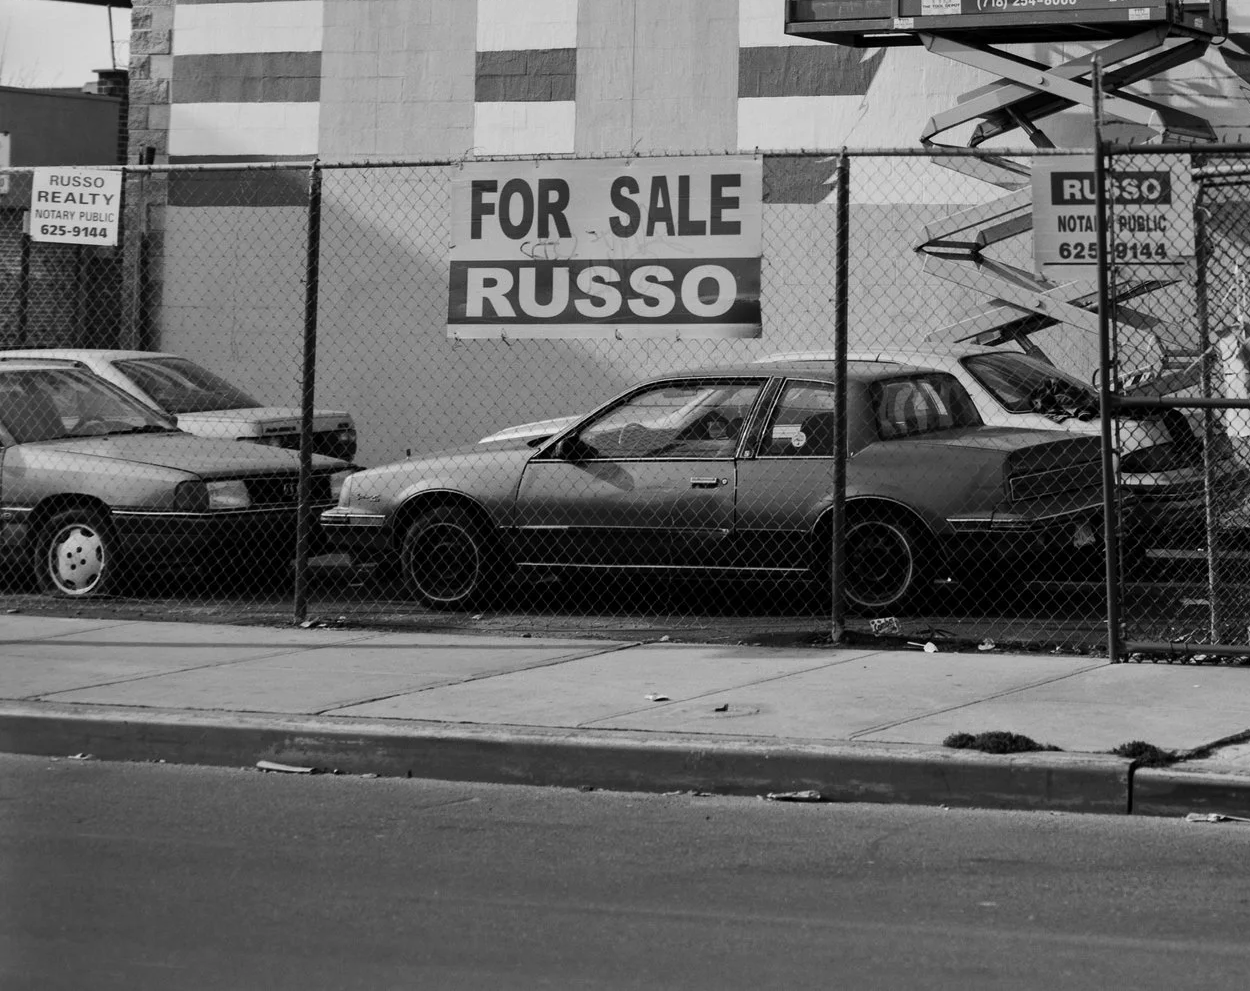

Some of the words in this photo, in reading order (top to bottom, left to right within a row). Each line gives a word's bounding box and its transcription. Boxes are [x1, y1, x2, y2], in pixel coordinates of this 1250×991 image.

[49, 175, 105, 188] RUSSO
[37, 190, 115, 206] REALTY
[471, 178, 572, 240] FOR
[609, 174, 742, 238] SALE
[35, 209, 76, 221] NOTARY
[79, 211, 115, 223] PUBLIC
[1119, 215, 1167, 232] PUBLIC
[40, 224, 108, 238] 625-9144
[465, 264, 737, 318] RUSSO
